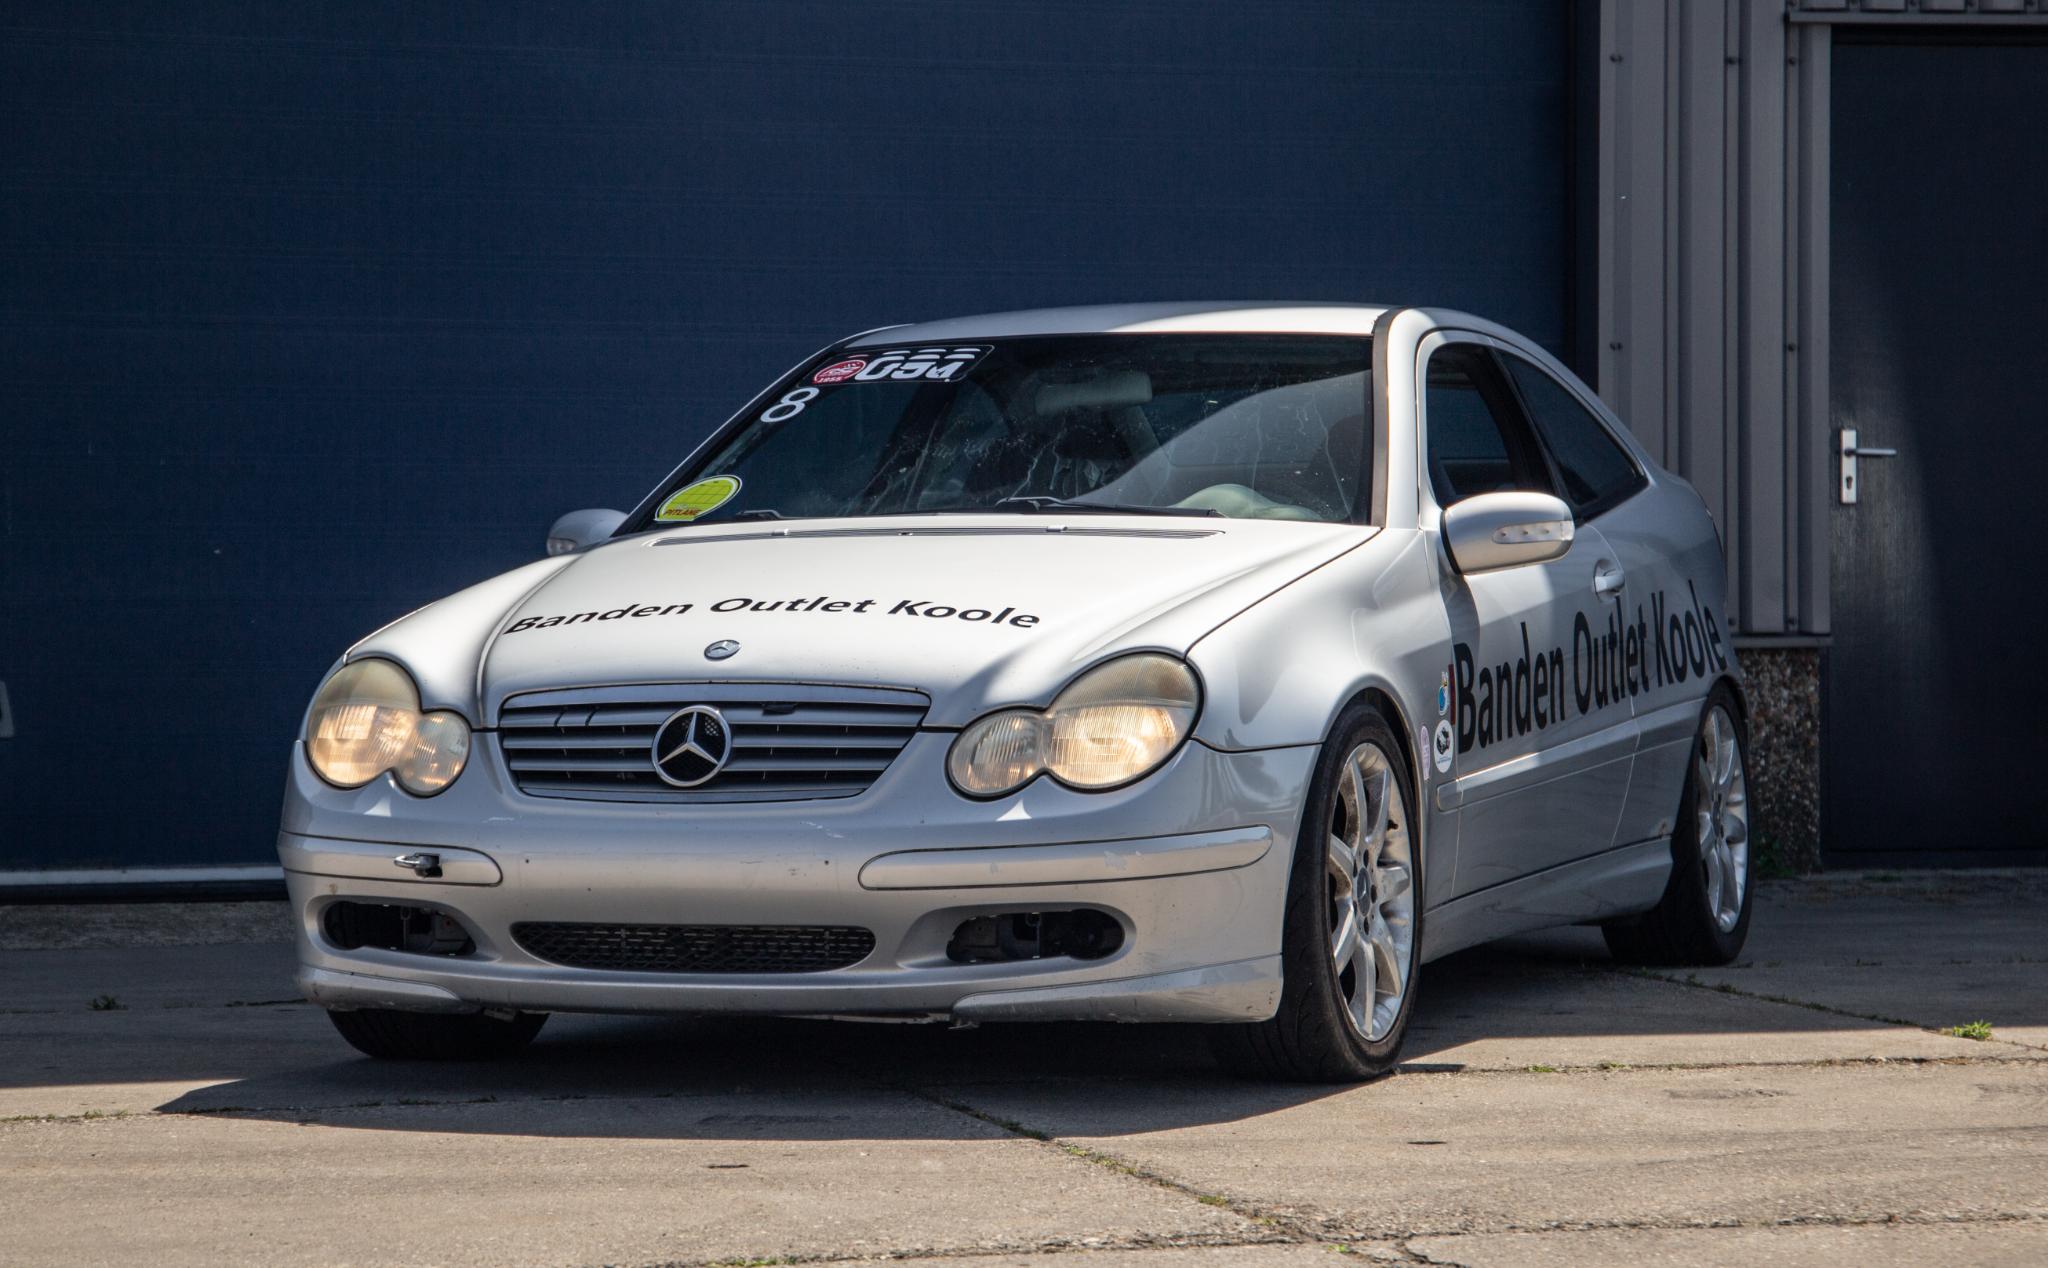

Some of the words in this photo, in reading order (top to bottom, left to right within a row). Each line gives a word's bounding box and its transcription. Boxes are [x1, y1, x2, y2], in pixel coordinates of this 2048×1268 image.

[760, 387, 820, 423] 8
[503, 603, 694, 635] Banden
[709, 596, 877, 613] Outlet
[886, 599, 1041, 629] Koole
[1453, 621, 1566, 755] Banden
[1573, 595, 1650, 716] Outlet
[1650, 578, 1728, 688] Koole
